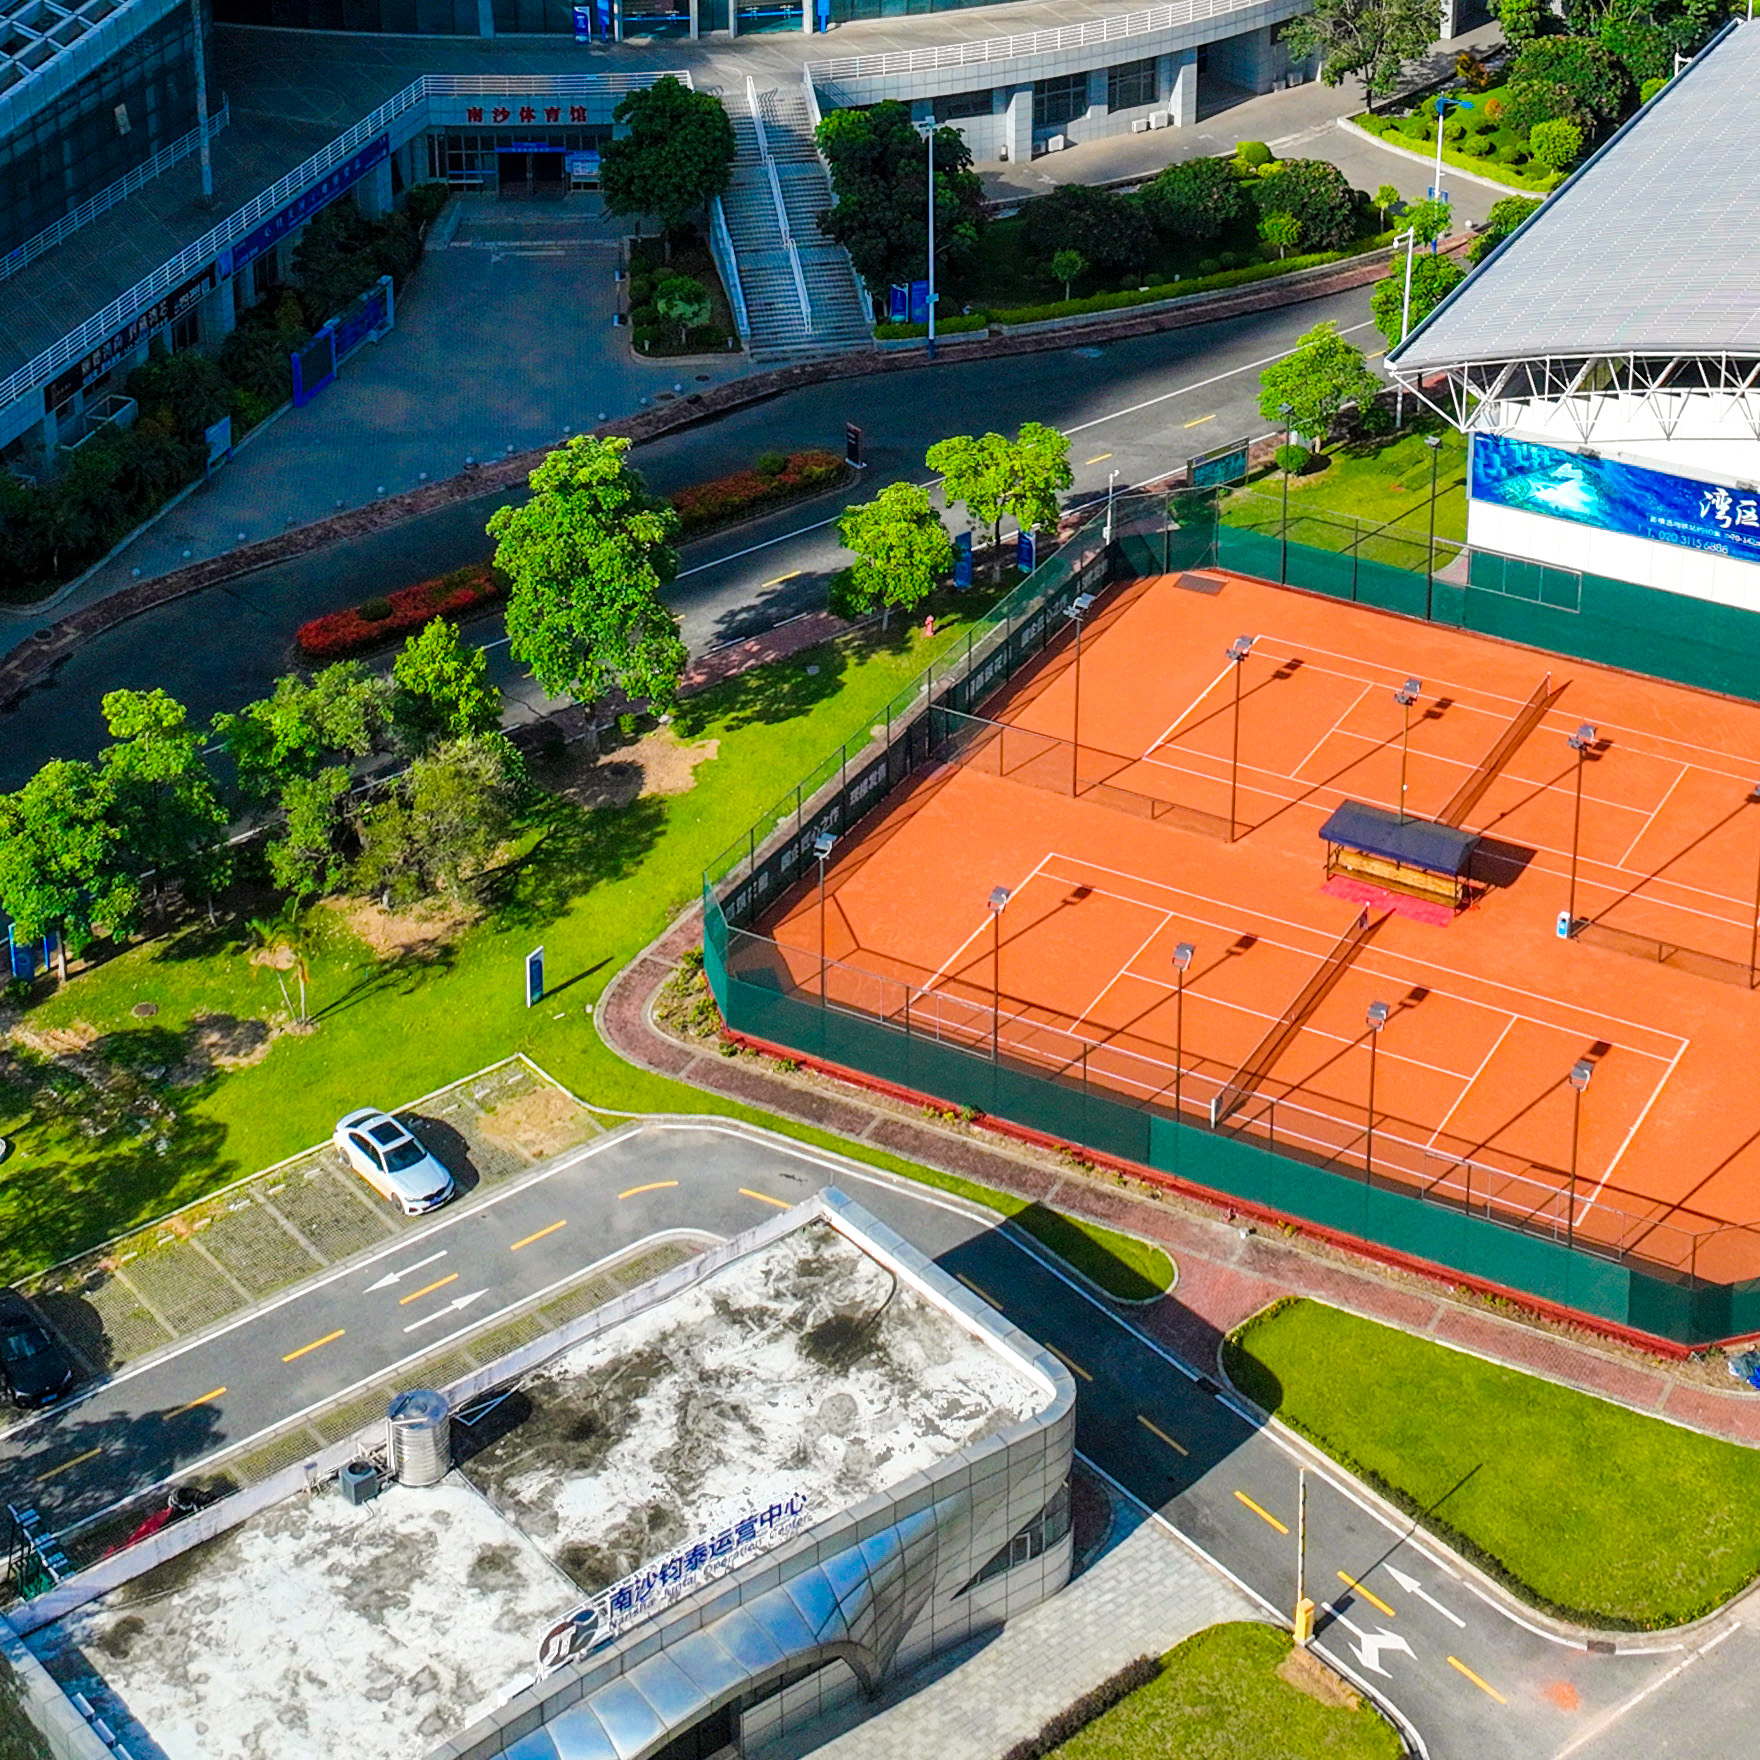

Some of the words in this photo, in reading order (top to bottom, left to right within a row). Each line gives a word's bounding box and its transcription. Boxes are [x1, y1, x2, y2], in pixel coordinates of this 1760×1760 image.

[466, 106, 588, 123] 南沙体育馆
[1658, 530, 1678, 543] 020
[1680, 535, 1701, 548] 3115
[1703, 541, 1729, 554] 6888
[610, 1492, 807, 1613] 南沙钧泰运营中心
[704, 1538, 763, 1574] Operation
